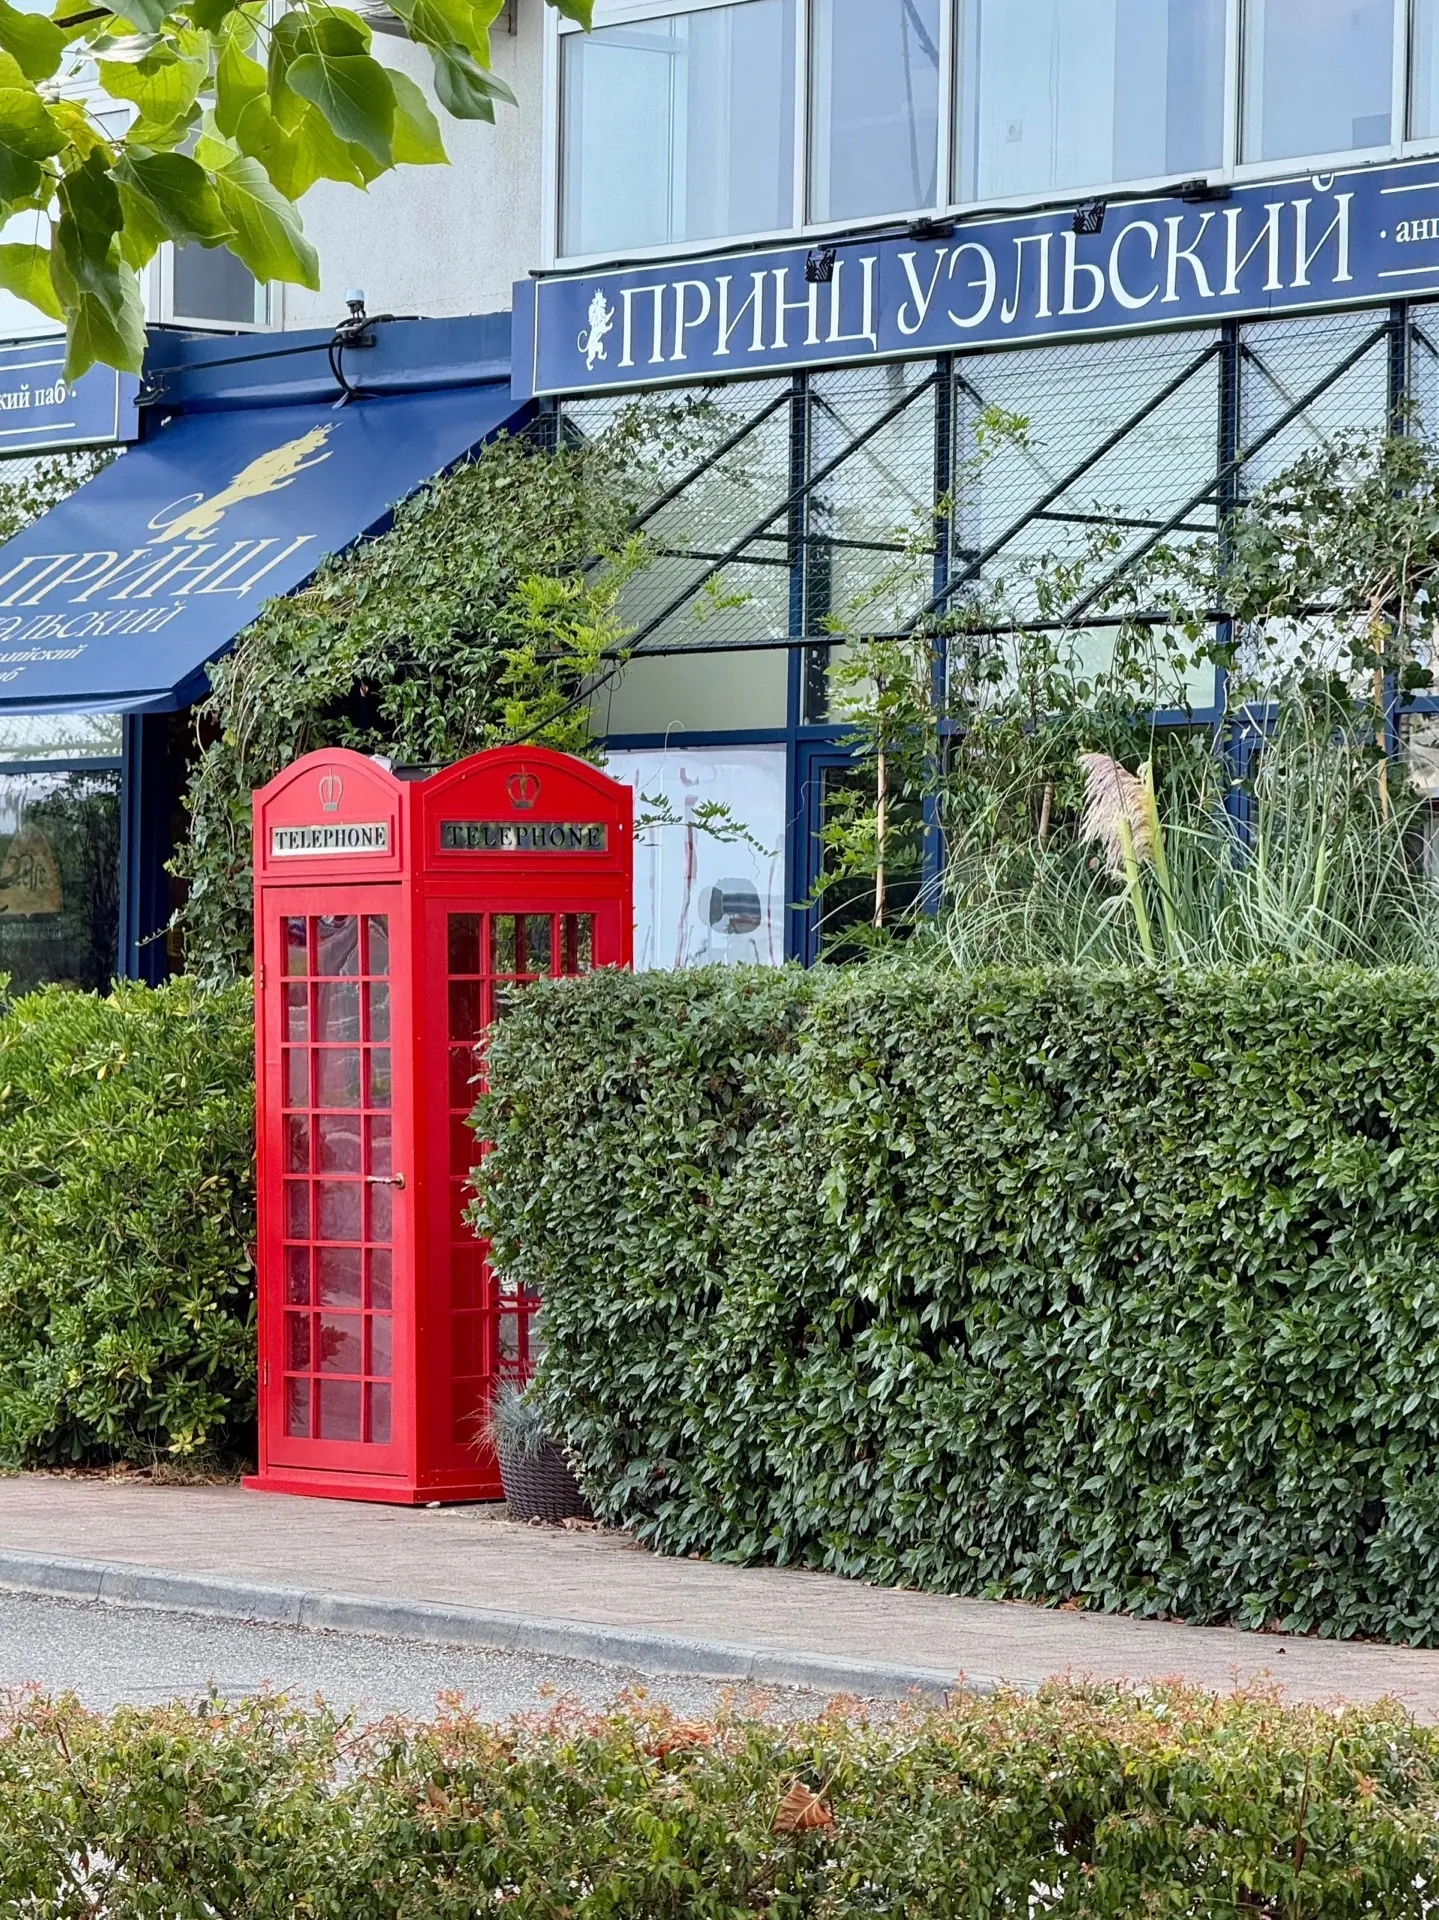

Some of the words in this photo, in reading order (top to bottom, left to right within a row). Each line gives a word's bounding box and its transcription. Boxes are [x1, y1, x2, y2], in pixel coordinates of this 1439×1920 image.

[617, 256, 878, 368] ПРИНЦ
[897, 172, 1355, 335] УЭЛЬСКИЙ
[34, 378, 66, 407] паб
[0, 534, 317, 608] ПРИНЦ
[0, 600, 187, 641] ЭЛЬСКИЙ
[275, 827, 386, 850] TELEPHONE
[447, 826, 601, 847] TELEPHONE
